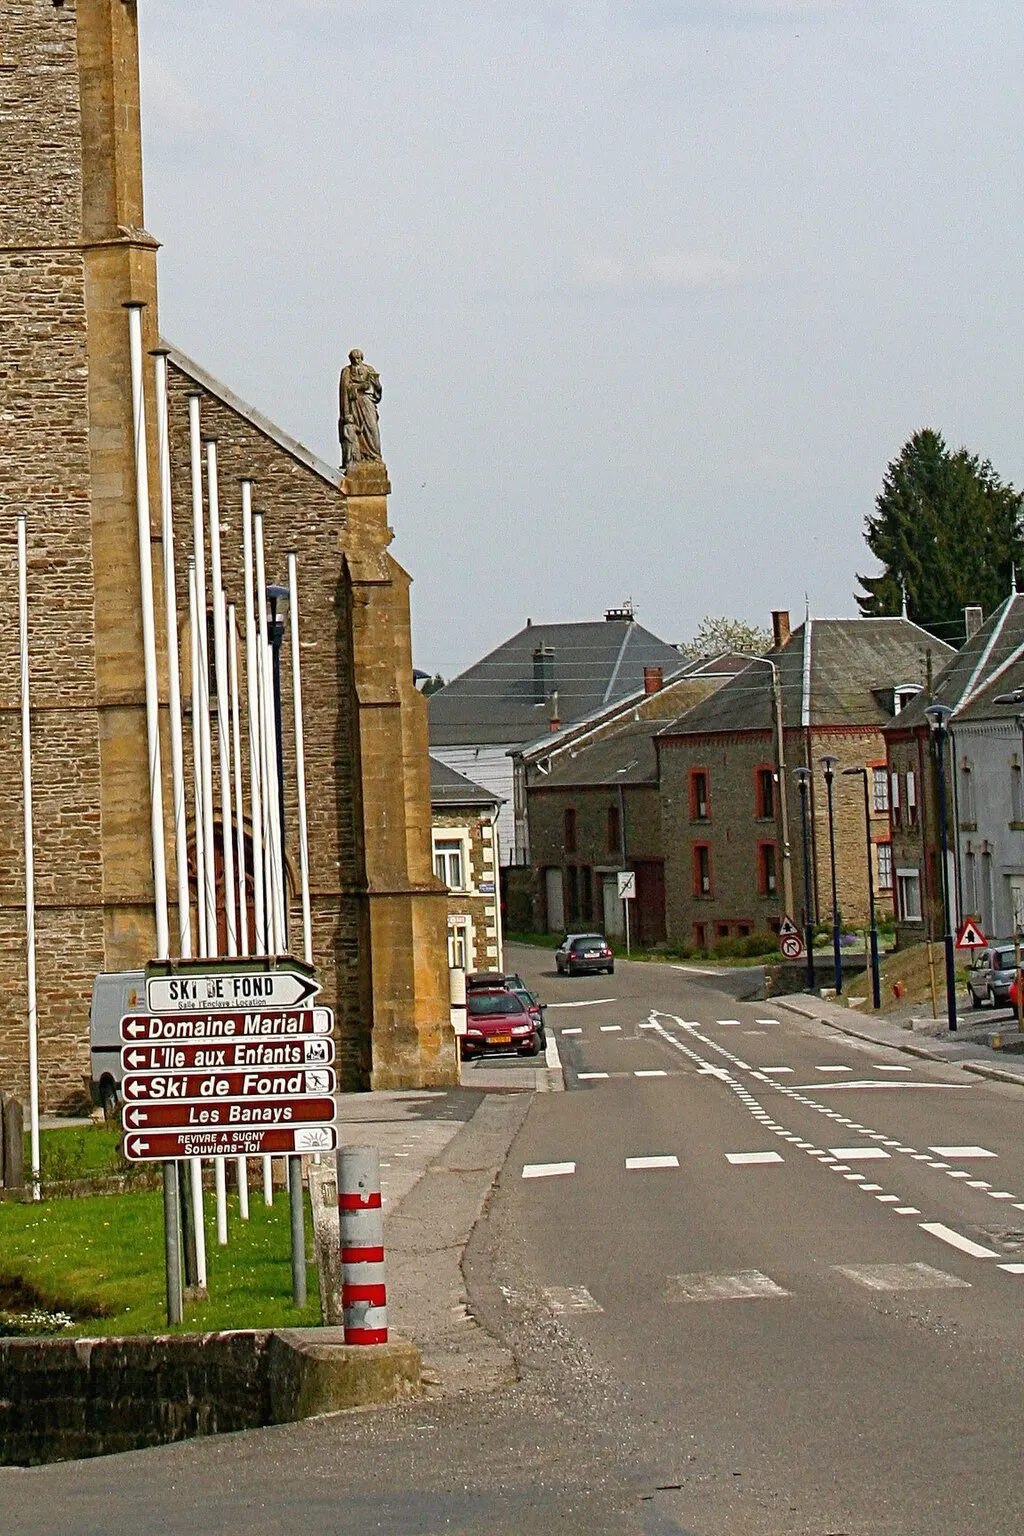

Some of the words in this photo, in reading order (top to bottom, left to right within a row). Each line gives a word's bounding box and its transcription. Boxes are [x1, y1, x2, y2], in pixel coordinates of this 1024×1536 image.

[169, 980, 197, 1000] SKI
[206, 978, 224, 998] DE
[233, 977, 274, 997] FOND
[235, 998, 267, 1007] Location
[148, 1016, 236, 1039] Domaine
[243, 1013, 305, 1035] Marial
[150, 1047, 185, 1068] L'Ile
[194, 1050, 226, 1067] aux
[234, 1044, 301, 1065] Enfants
[149, 1076, 188, 1098] Ski
[200, 1075, 230, 1096] de
[242, 1073, 303, 1095] Fond
[189, 1107, 220, 1124] Les
[229, 1105, 293, 1123] Banays
[177, 1133, 217, 1144] REVIVRE
[221, 1132, 227, 1142] A
[232, 1131, 265, 1142] SUGNY
[184, 1141, 260, 1155] Souviens-Toi
